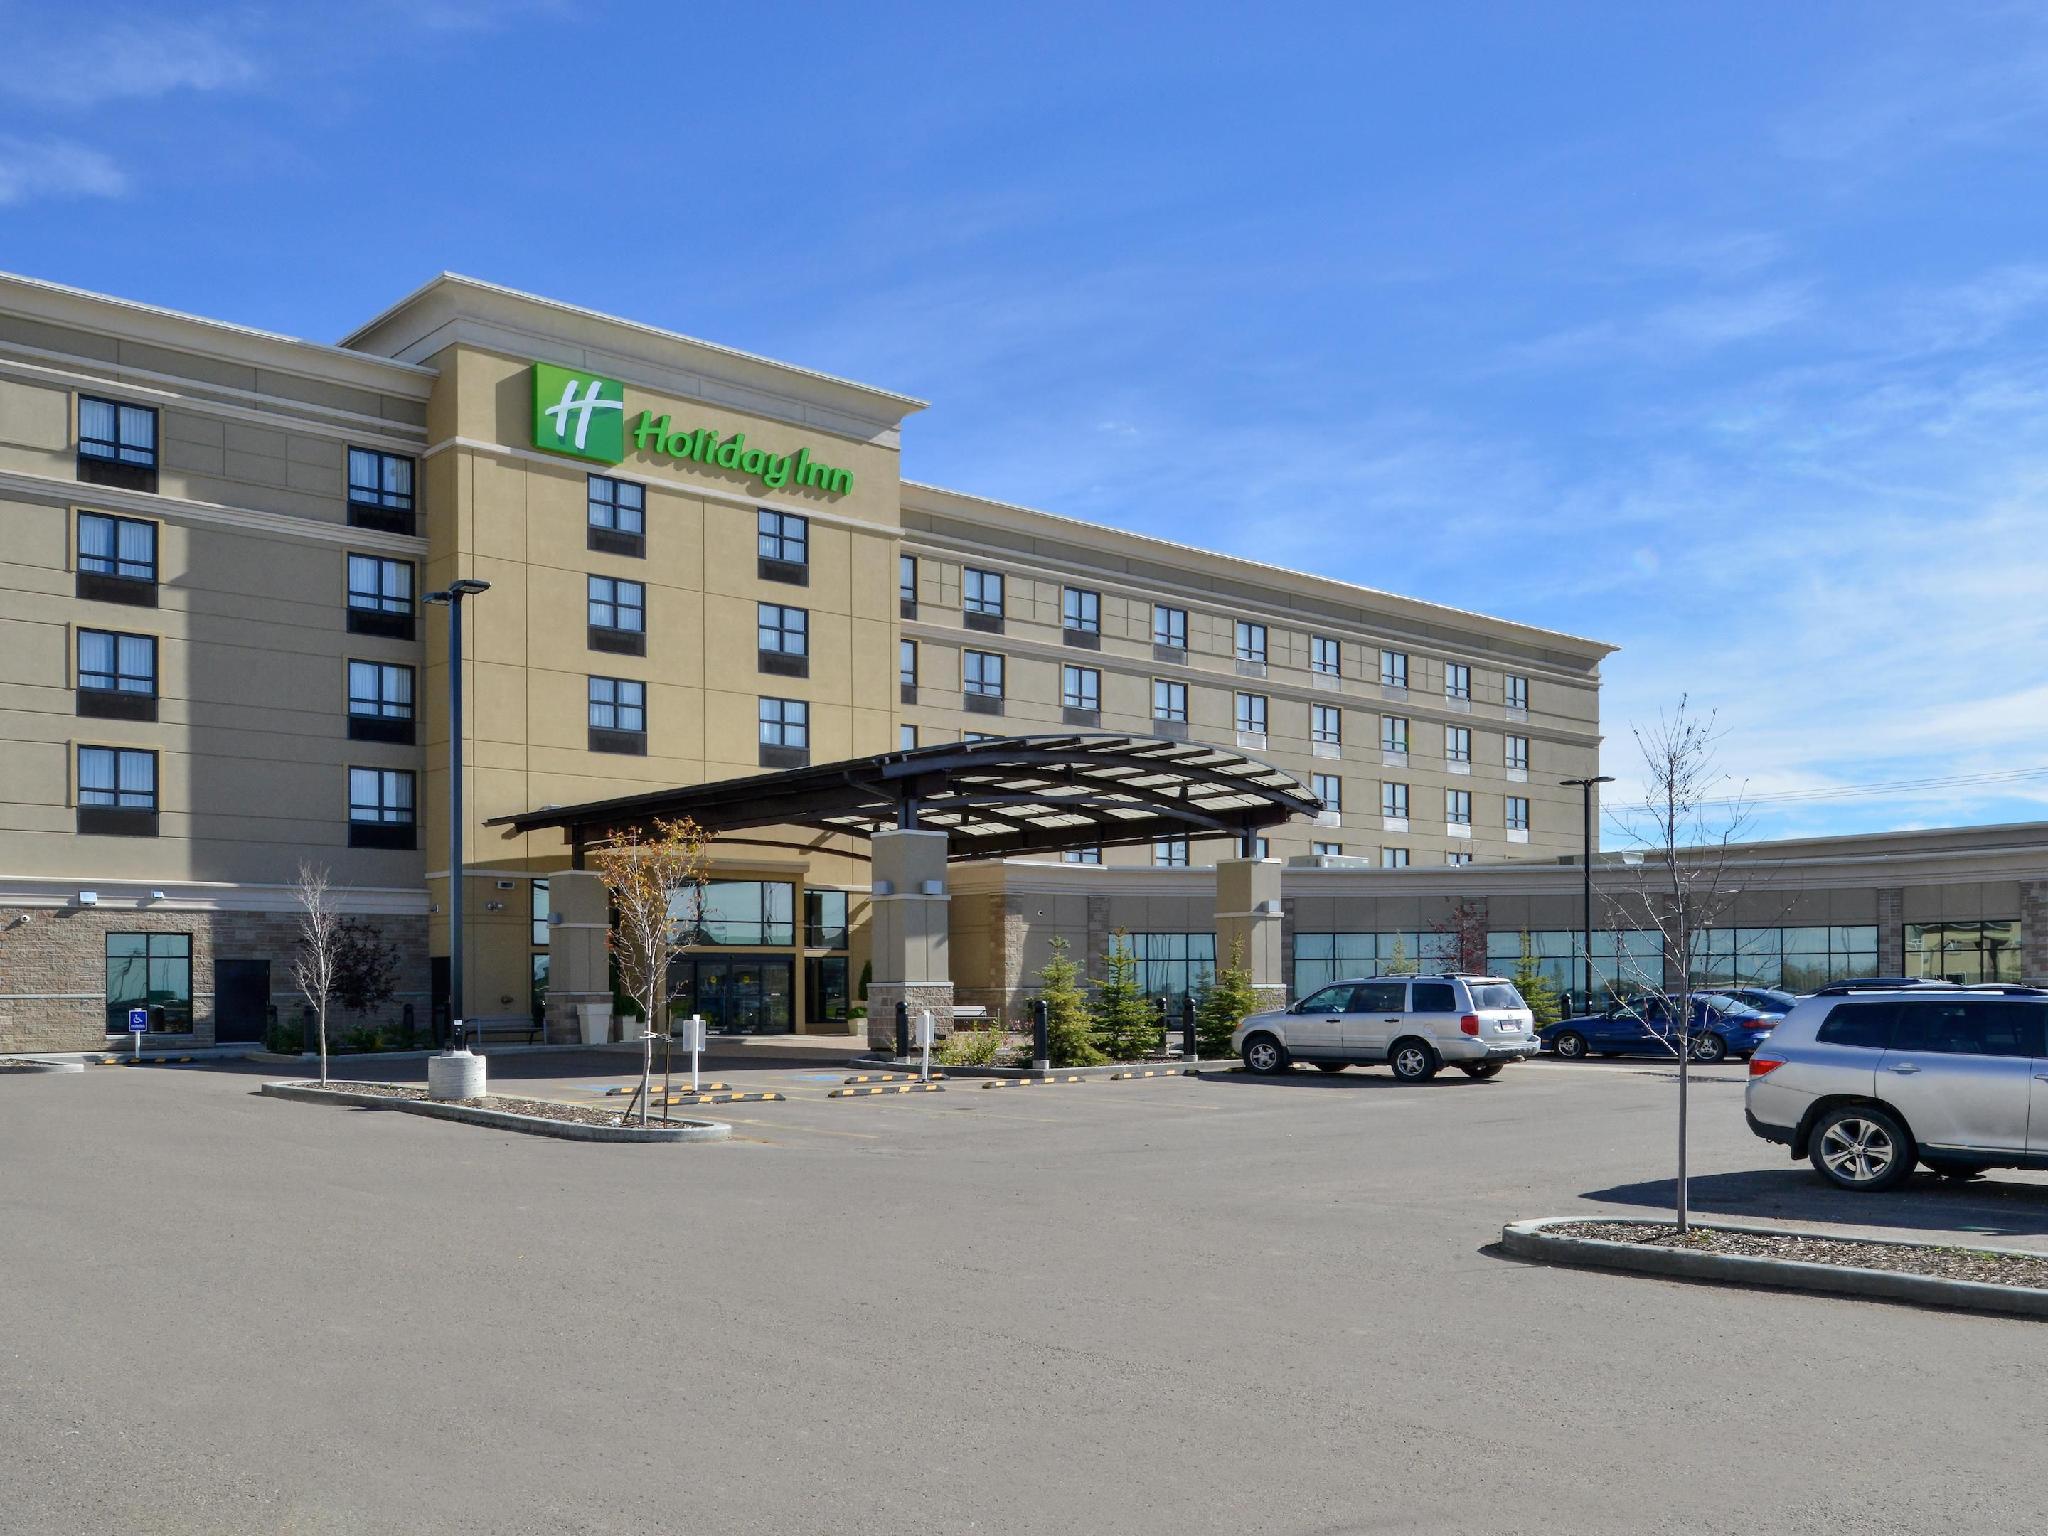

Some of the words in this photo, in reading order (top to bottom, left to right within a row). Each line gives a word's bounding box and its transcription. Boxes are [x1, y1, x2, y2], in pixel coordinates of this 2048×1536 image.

[545, 379, 623, 450] H
[633, 409, 792, 488] Holiday
[794, 447, 854, 496] Inn
